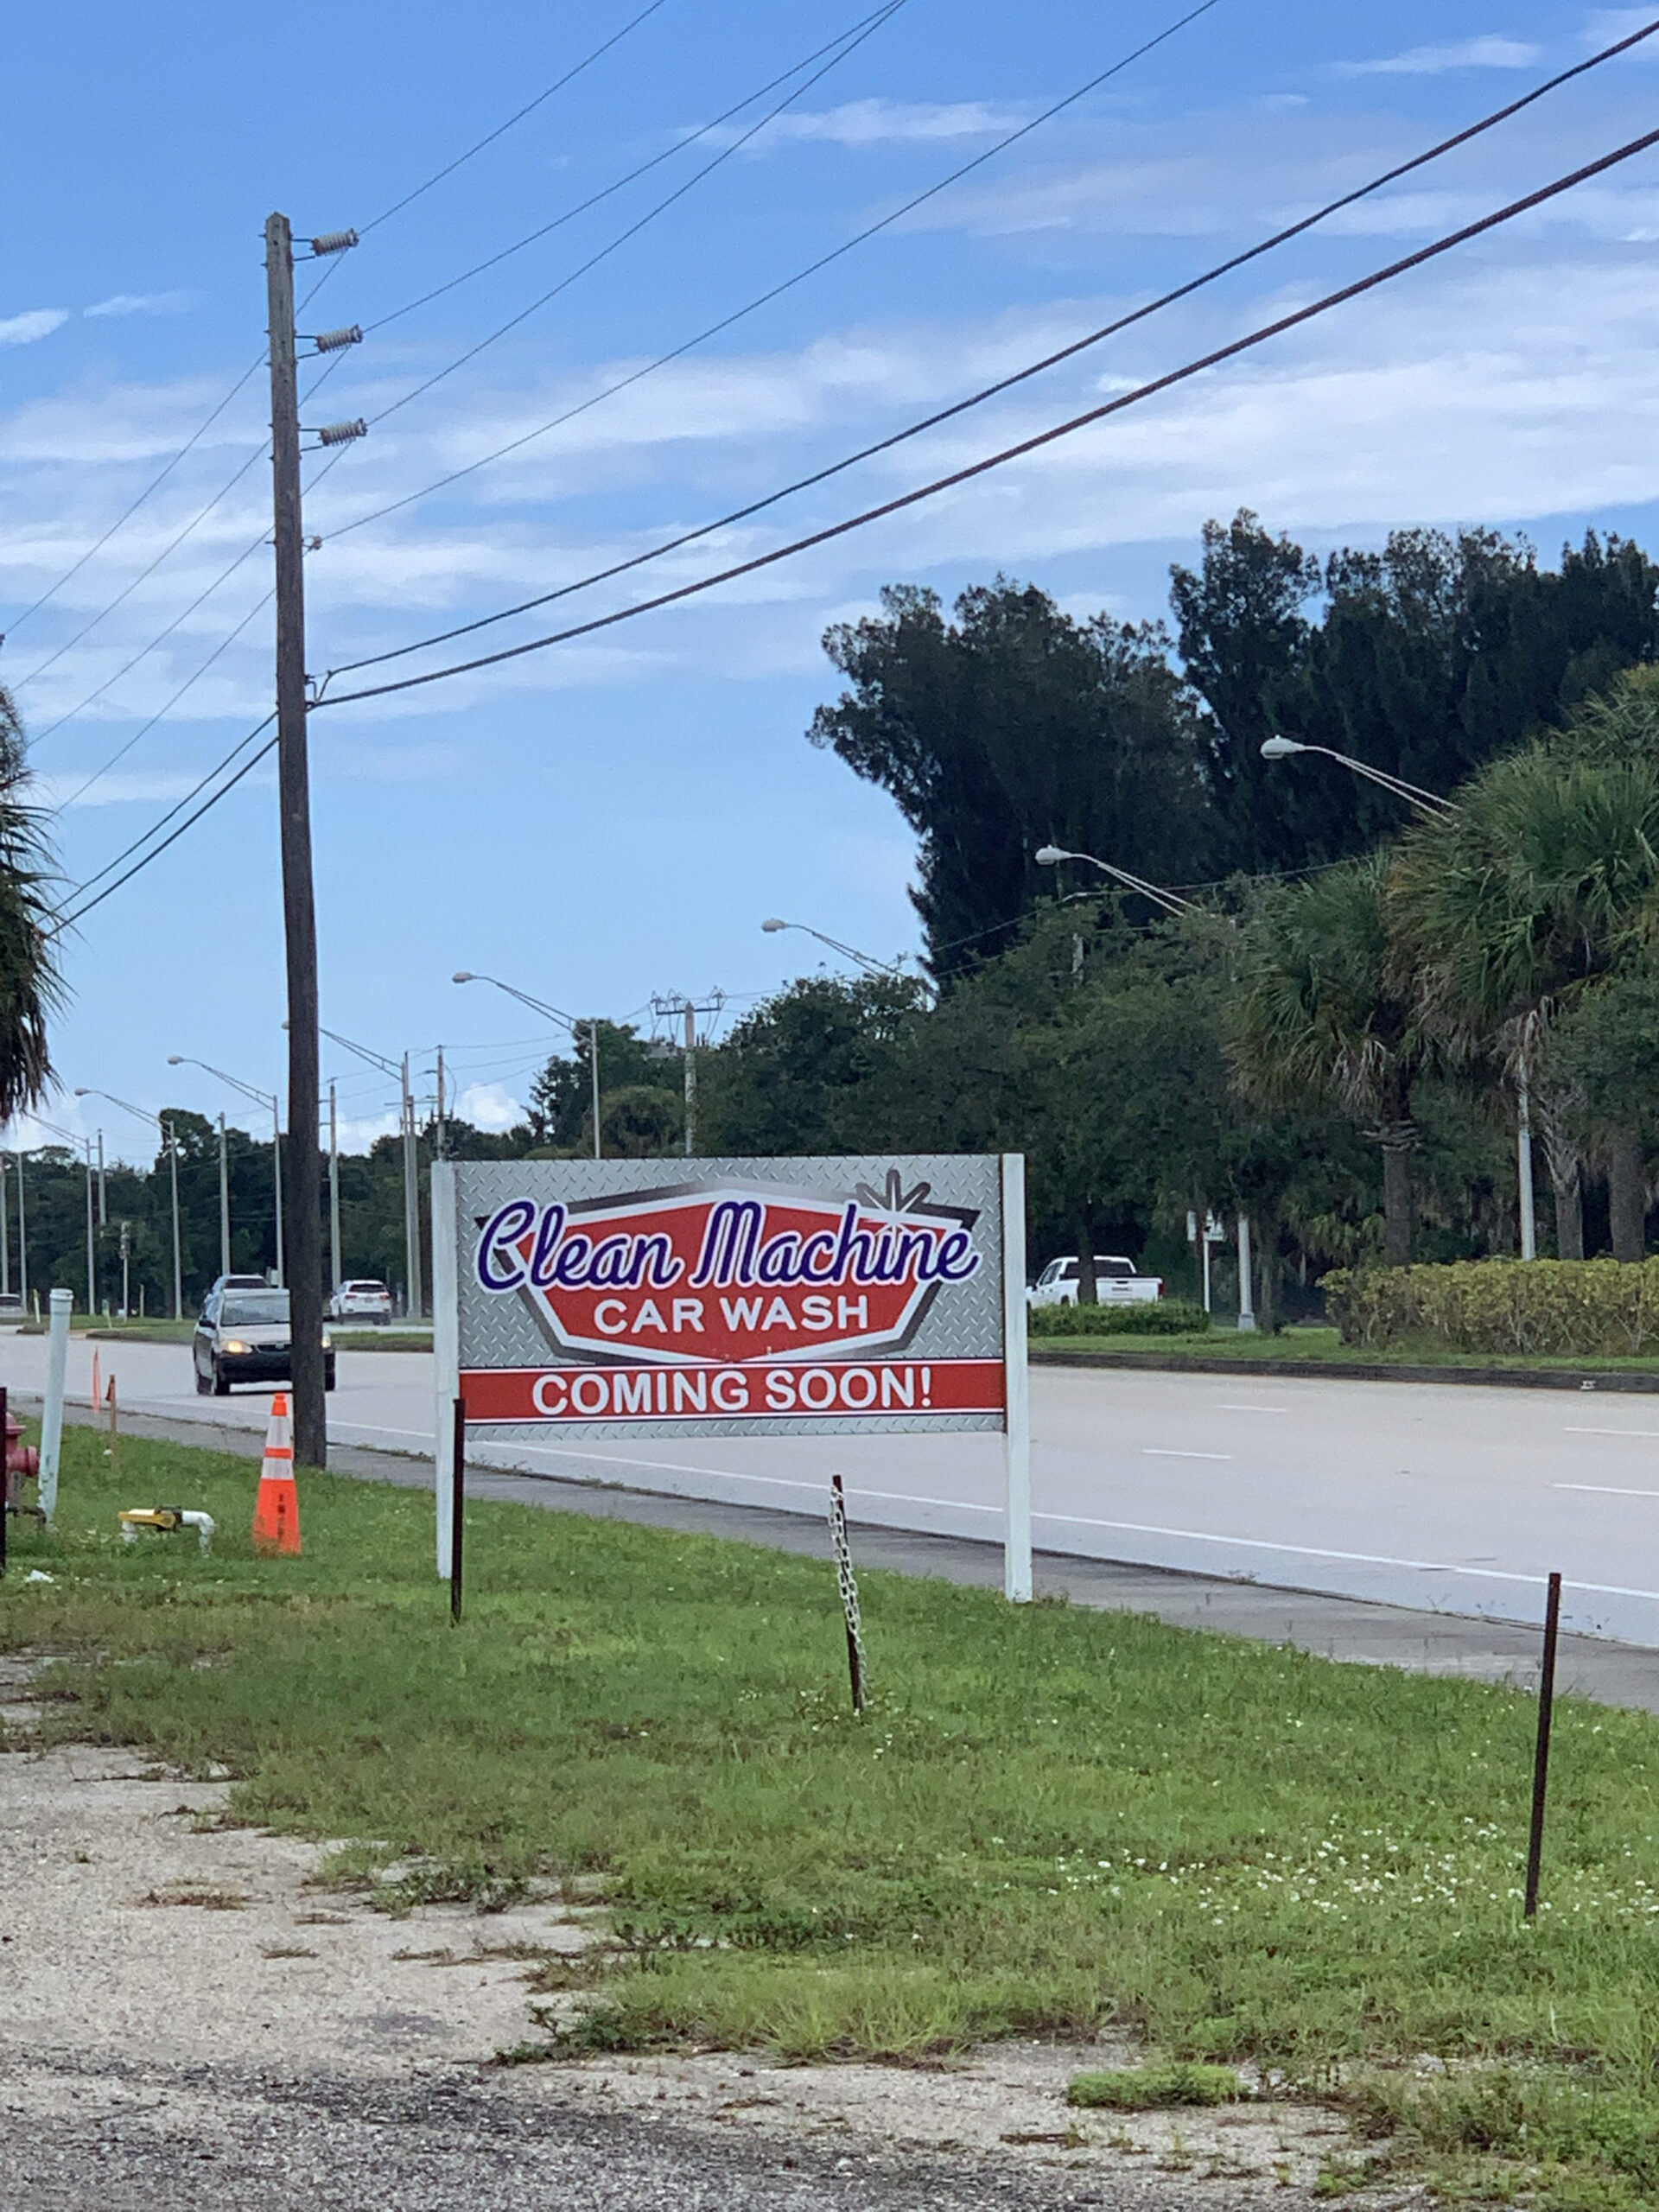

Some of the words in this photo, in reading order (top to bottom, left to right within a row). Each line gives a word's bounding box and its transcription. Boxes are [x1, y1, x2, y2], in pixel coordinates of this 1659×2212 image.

[476, 1200, 681, 1291] Clean
[690, 1199, 980, 1286] Machine
[593, 1298, 706, 1335] CAR
[719, 1294, 868, 1333] WASH
[532, 1373, 750, 1415] COMING
[765, 1366, 932, 1409] SOON!
